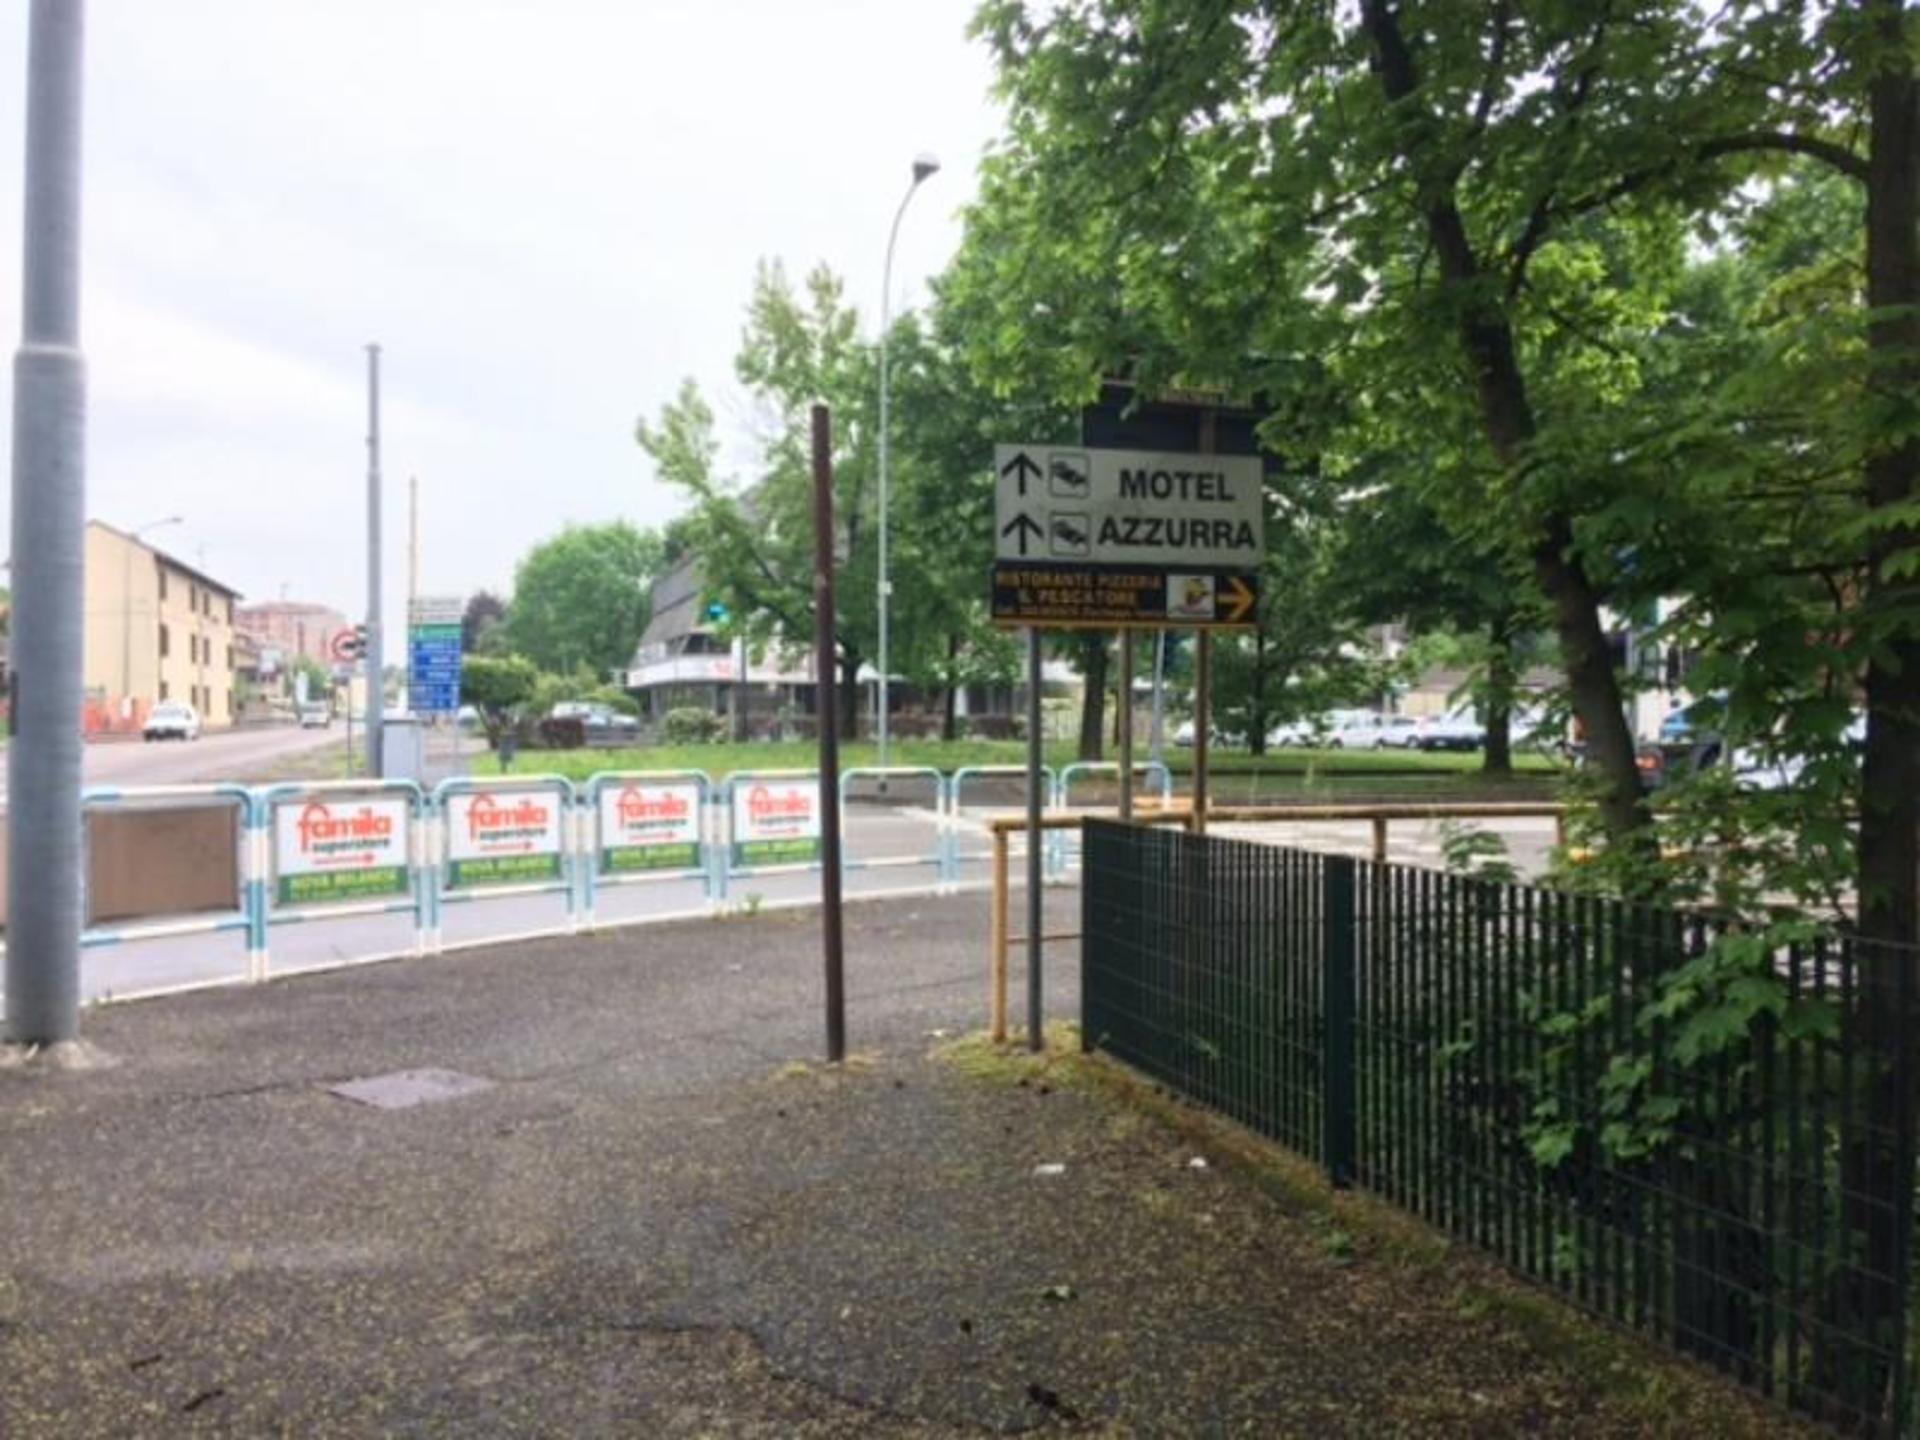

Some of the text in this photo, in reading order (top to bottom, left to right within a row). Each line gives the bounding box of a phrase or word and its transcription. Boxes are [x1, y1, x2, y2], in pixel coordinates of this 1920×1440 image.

[1119, 469, 1236, 501] MOTEL
[1097, 516, 1256, 549] AZZURRA
[298, 803, 391, 853] famila
[467, 793, 547, 842] famila
